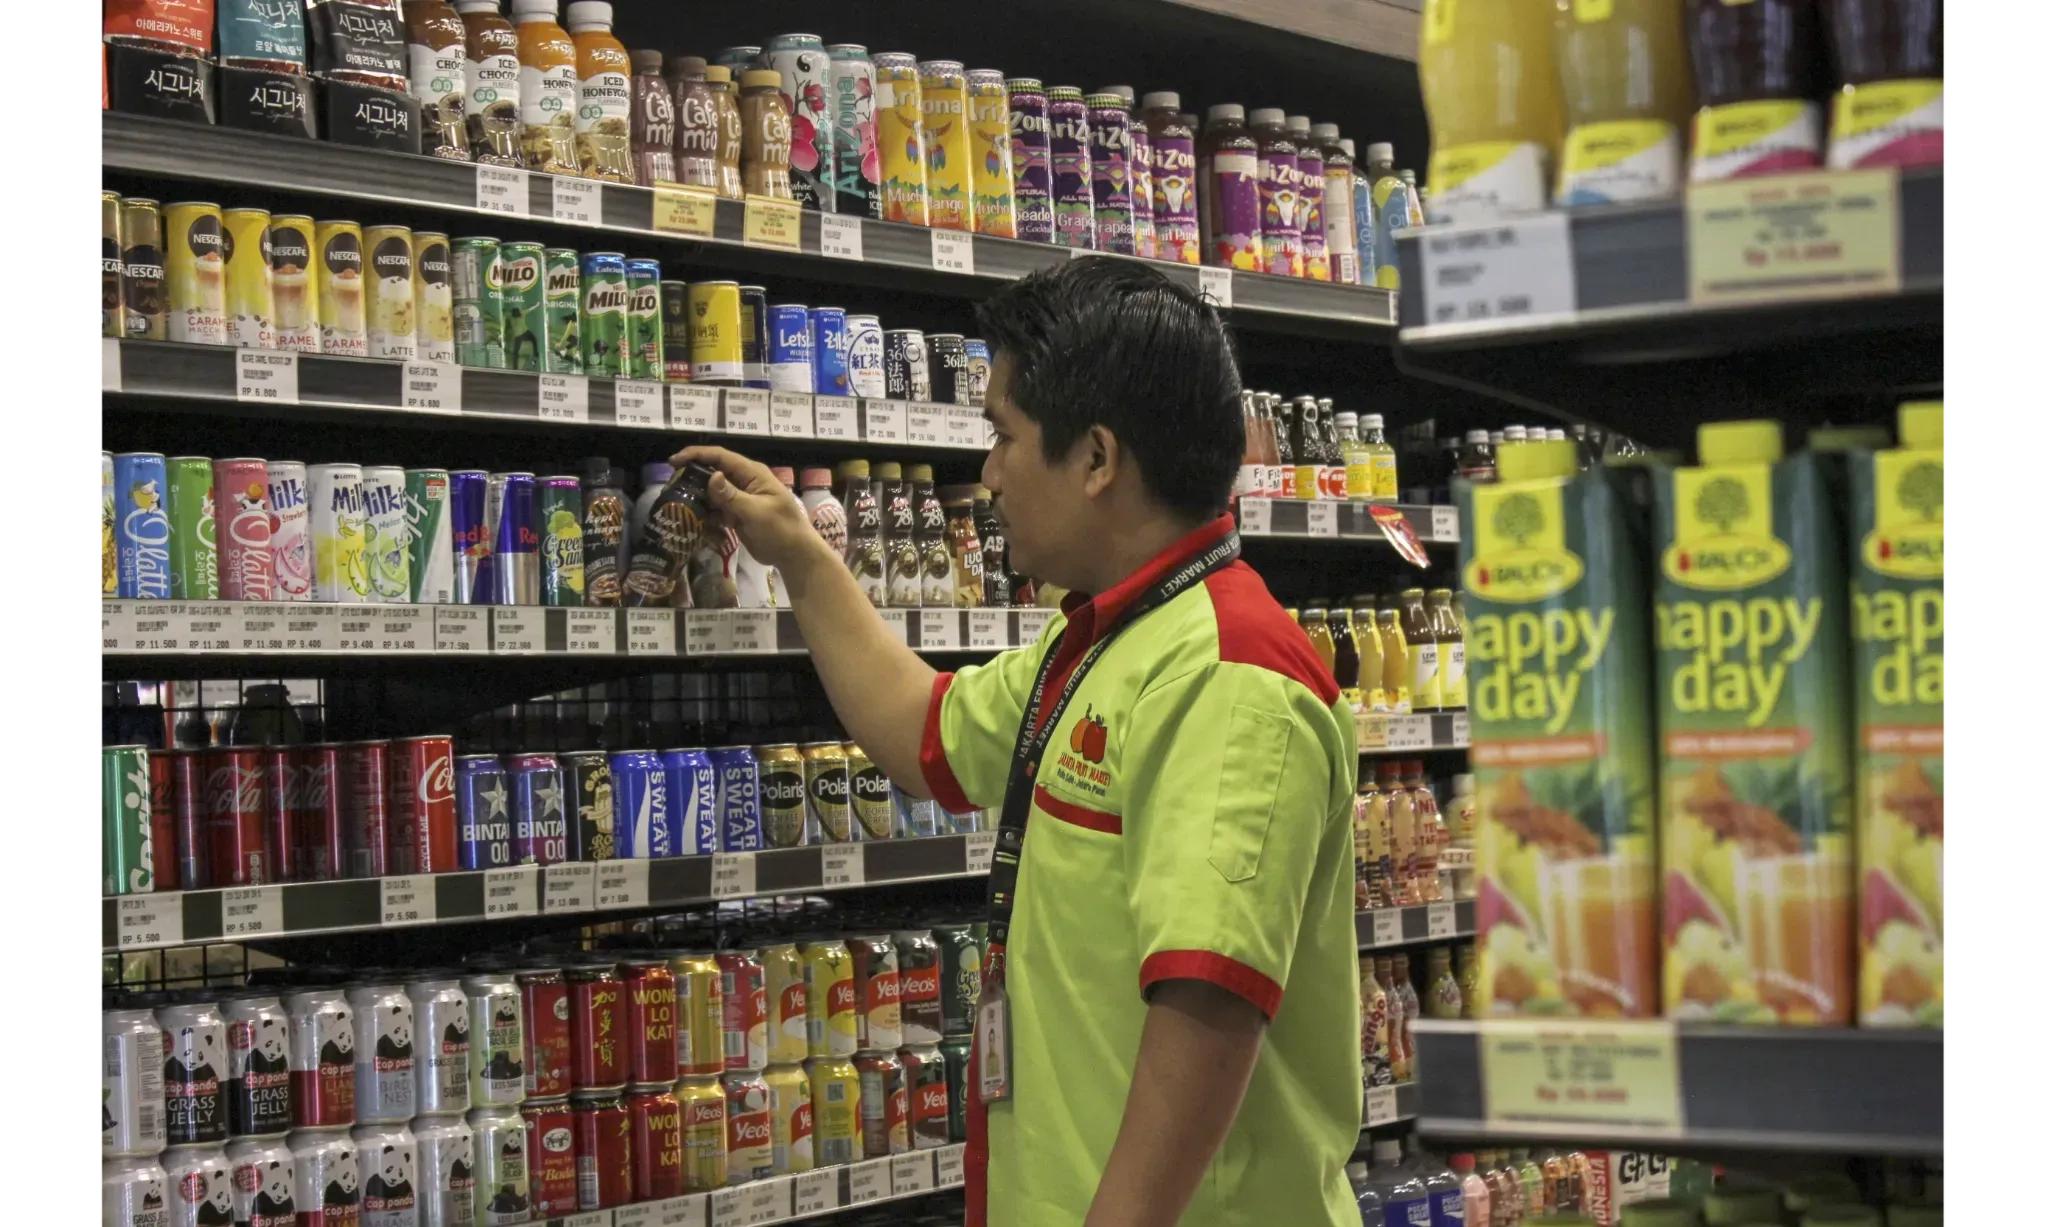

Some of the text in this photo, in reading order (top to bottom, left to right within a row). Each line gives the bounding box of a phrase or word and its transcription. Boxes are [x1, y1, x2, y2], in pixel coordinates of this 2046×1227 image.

[136, 18, 181, 34] 아메리카노
[339, 13, 395, 37] 시그니처
[604, 77, 624, 86] ICED
[682, 94, 718, 127] Cafe
[683, 127, 718, 150] mio
[834, 76, 866, 199] AriZona
[382, 346, 414, 356] LATTE
[852, 353, 880, 369] 紅茶
[1160, 542, 1231, 599] FRUIT MARKET
[150, 640, 177, 649] 11.500
[1673, 650, 1787, 728] day
[1476, 661, 1580, 736] day
[1037, 699, 1065, 748] MARKET
[760, 782, 804, 801] Polaris
[727, 768, 745, 849] SWEAT
[137, 933, 160, 943] 5.500
[900, 977, 935, 995] Yeo's
[651, 1007, 669, 1021] LO
[646, 1026, 673, 1041] KAT
[168, 1096, 215, 1111] GRASS
[170, 1110, 214, 1125] JELLY
[696, 1106, 722, 1121] Yeo's
[736, 1121, 770, 1142] Yeo's
